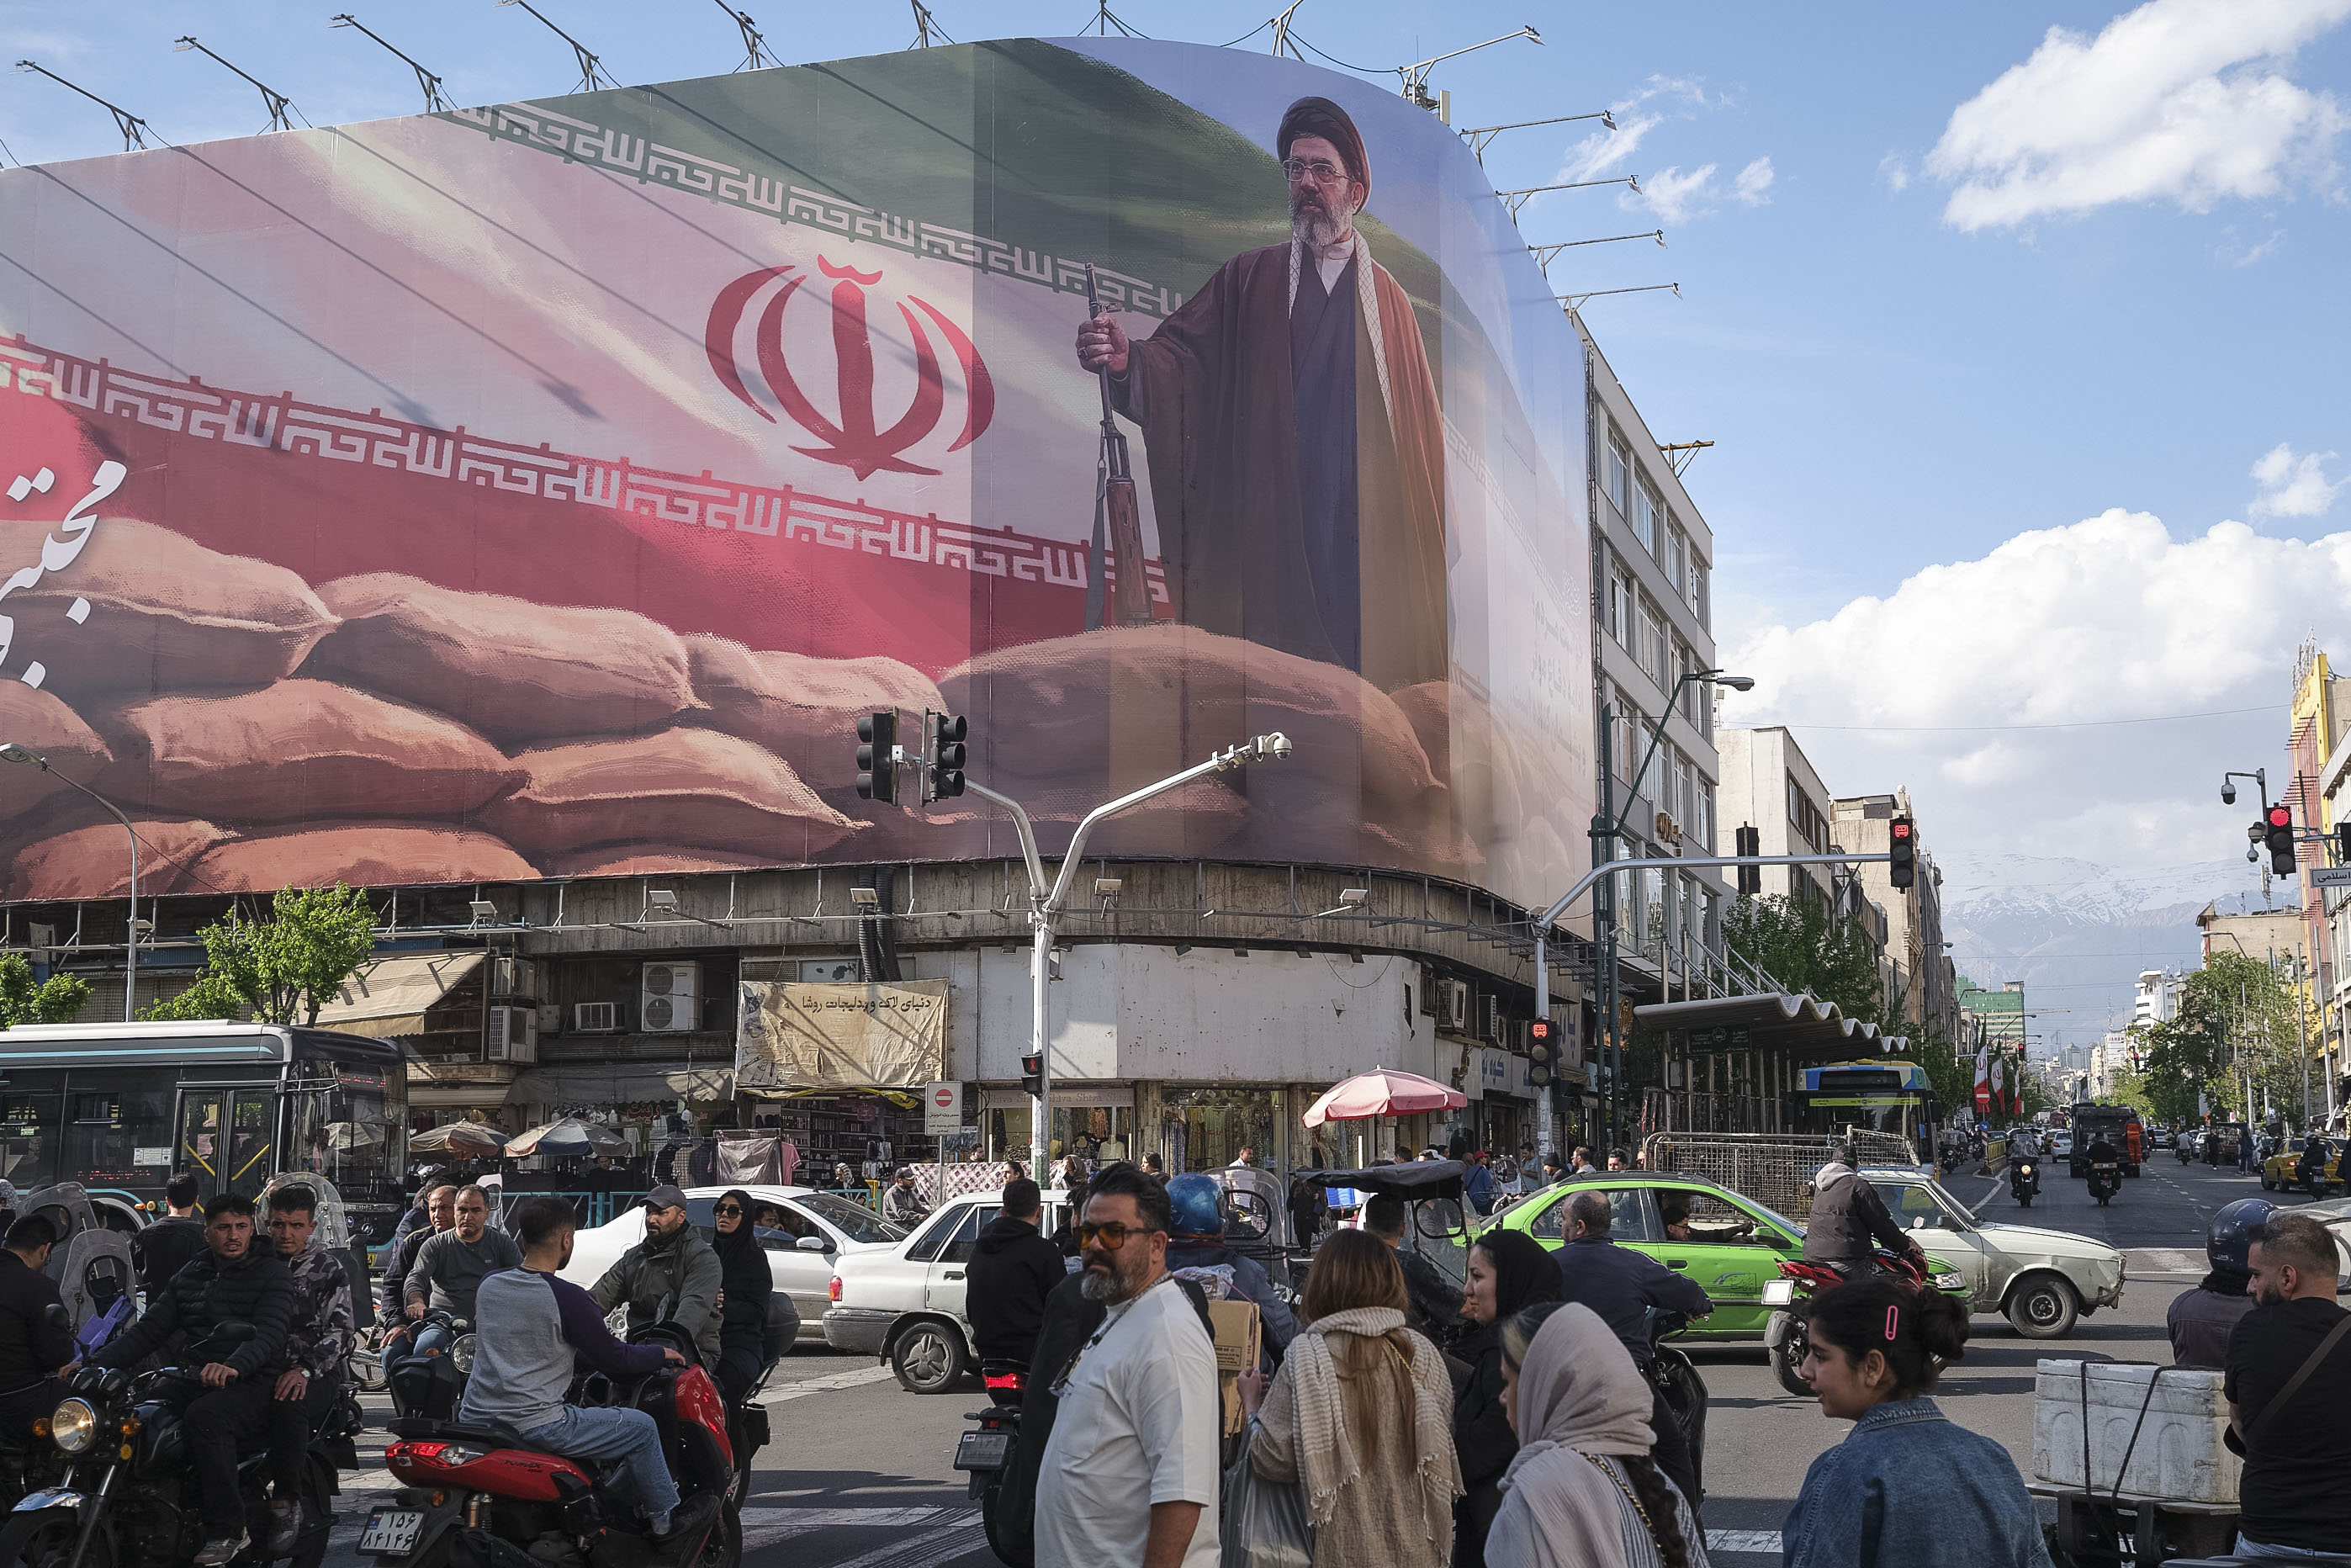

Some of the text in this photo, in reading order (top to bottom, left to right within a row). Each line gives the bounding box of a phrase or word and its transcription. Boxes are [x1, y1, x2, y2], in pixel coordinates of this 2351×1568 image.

[2317, 871, 2351, 883] اسلامی
[802, 996, 931, 1013] دنیای لاک و بدلیجات روشا
[1076, 1093, 1102, 1103] Shiva
